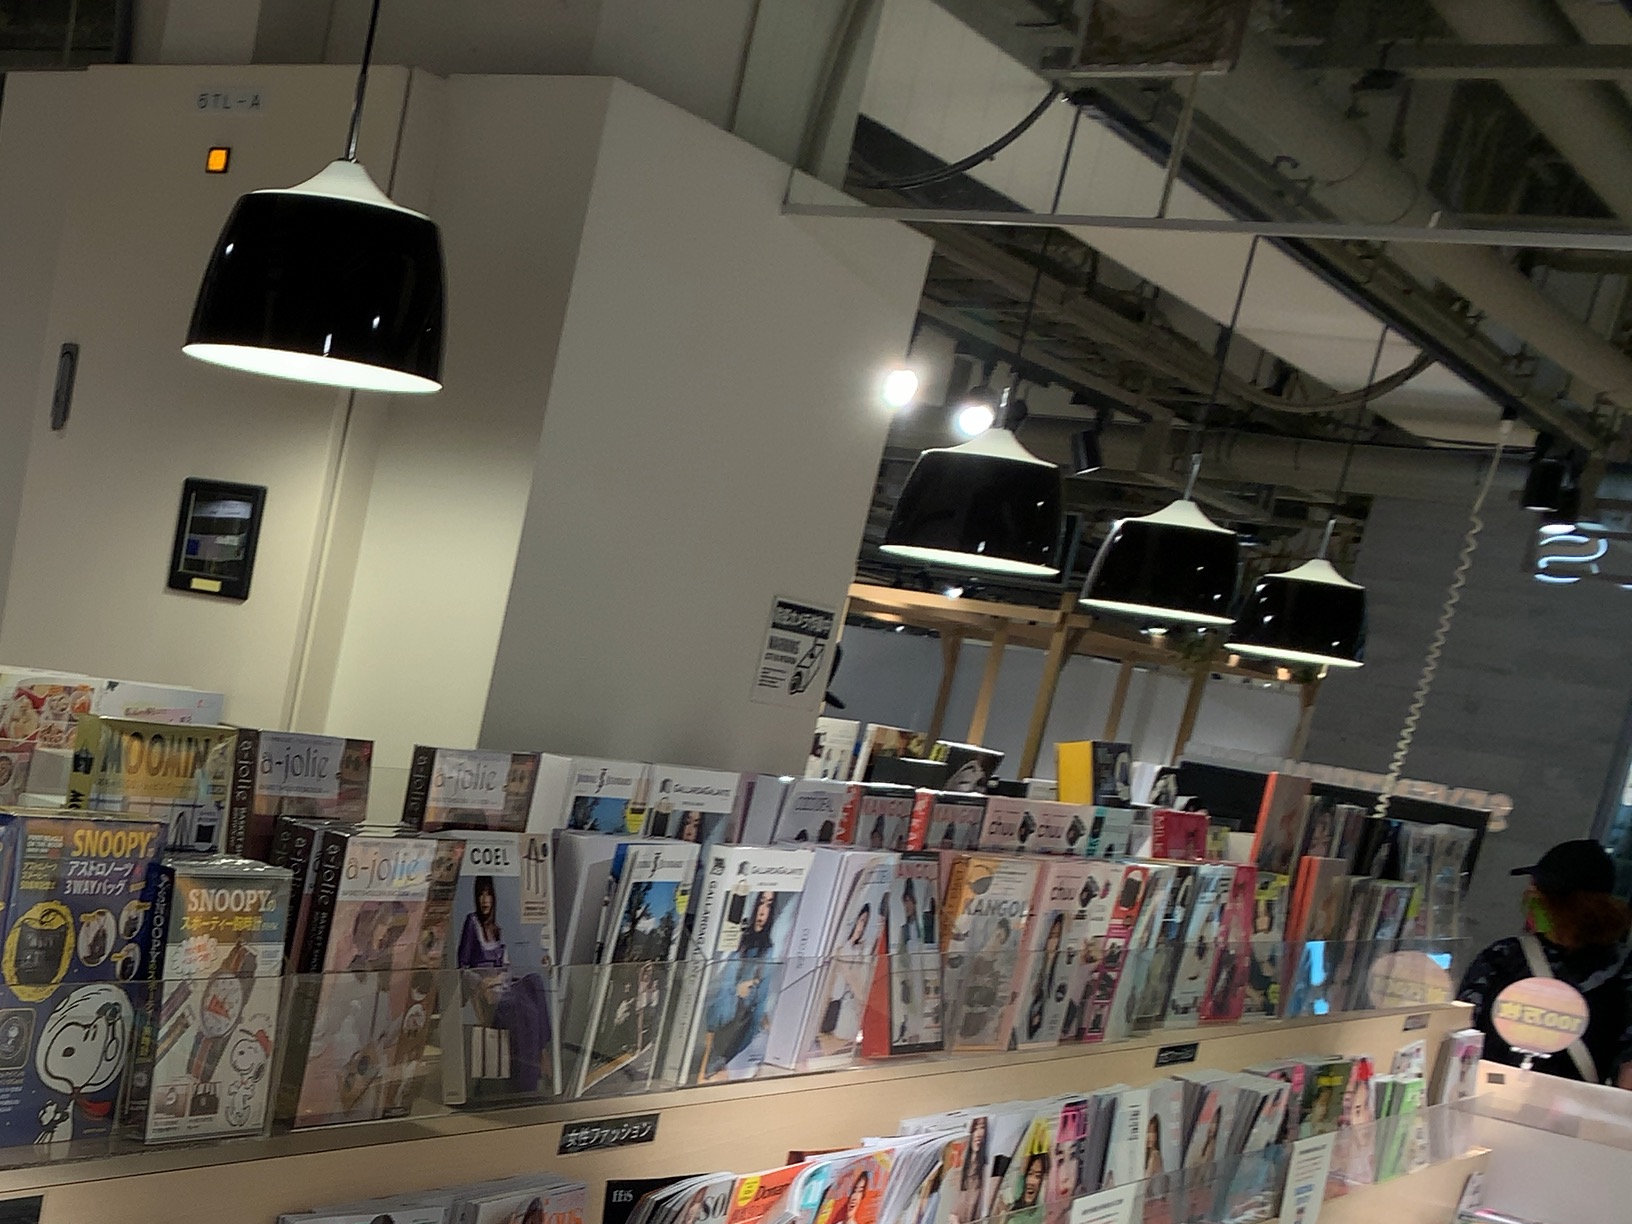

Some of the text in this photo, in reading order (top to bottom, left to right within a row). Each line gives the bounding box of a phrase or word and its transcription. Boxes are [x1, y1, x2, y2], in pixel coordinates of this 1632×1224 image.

[470, 846, 510, 867] COEL
[68, 860, 135, 879] アストロノーツ
[64, 879, 128, 896] 3WAYバッグ
[566, 1121, 652, 1148] 女性ファッション
